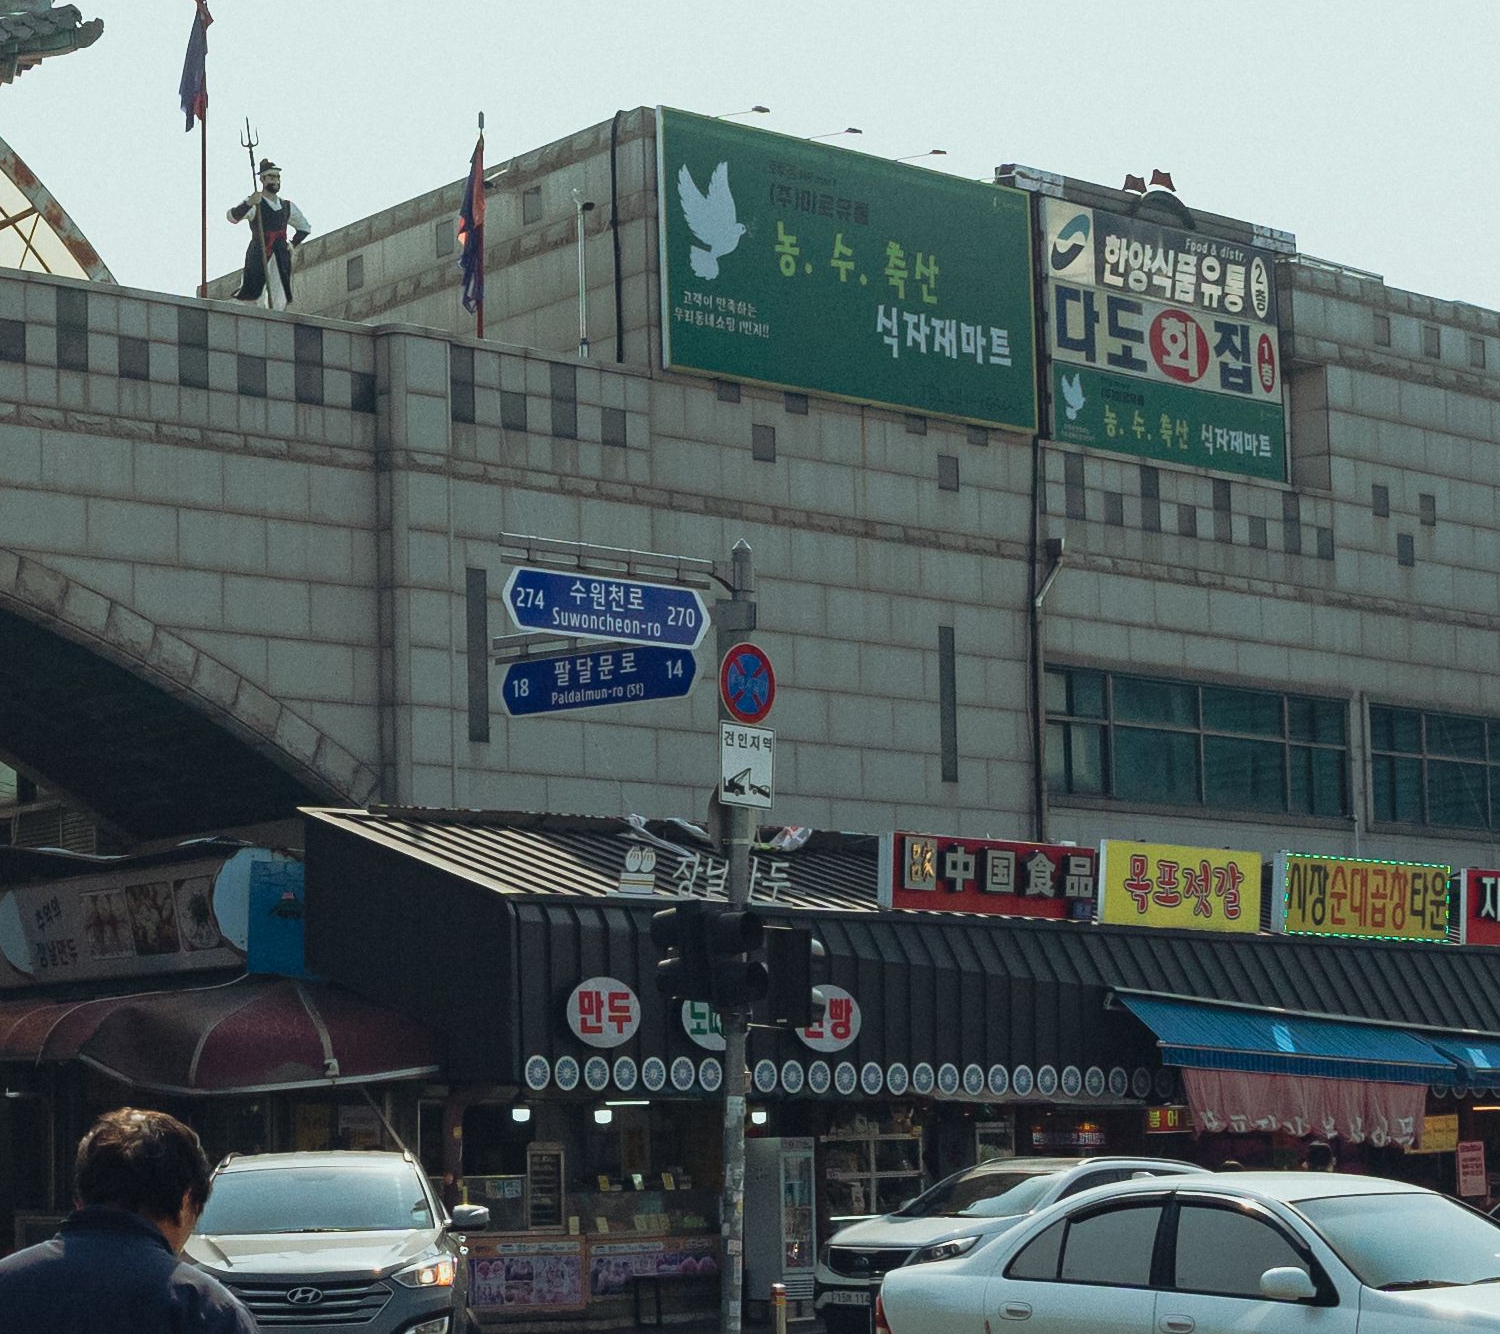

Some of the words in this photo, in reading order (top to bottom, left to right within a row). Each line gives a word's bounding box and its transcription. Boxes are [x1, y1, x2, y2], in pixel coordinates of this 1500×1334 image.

[884, 240, 941, 305] 축산
[1103, 233, 1247, 315] 한양식품유통
[876, 304, 1013, 367] 식자재마트
[1053, 283, 1253, 396] 다도회집
[1200, 423, 1273, 459] 식자재마트
[516, 587, 546, 610] 274
[569, 581, 646, 612] 수원천로
[667, 605, 696, 628] 270
[551, 606, 662, 638] Suwoncheon-ro
[512, 679, 530, 699] 18
[553, 652, 638, 687] 팔달문로
[665, 660, 684, 680] 14
[550, 685, 625, 707] Paldalmun-ro
[625, 681, 646, 699] (St)
[724, 730, 773, 754] 견인지역
[945, 845, 1095, 899] 中国食品
[1123, 854, 1244, 920] 목포젓갈
[1287, 863, 1448, 932] 시장순대곱창타운
[578, 990, 633, 1035] 만두
